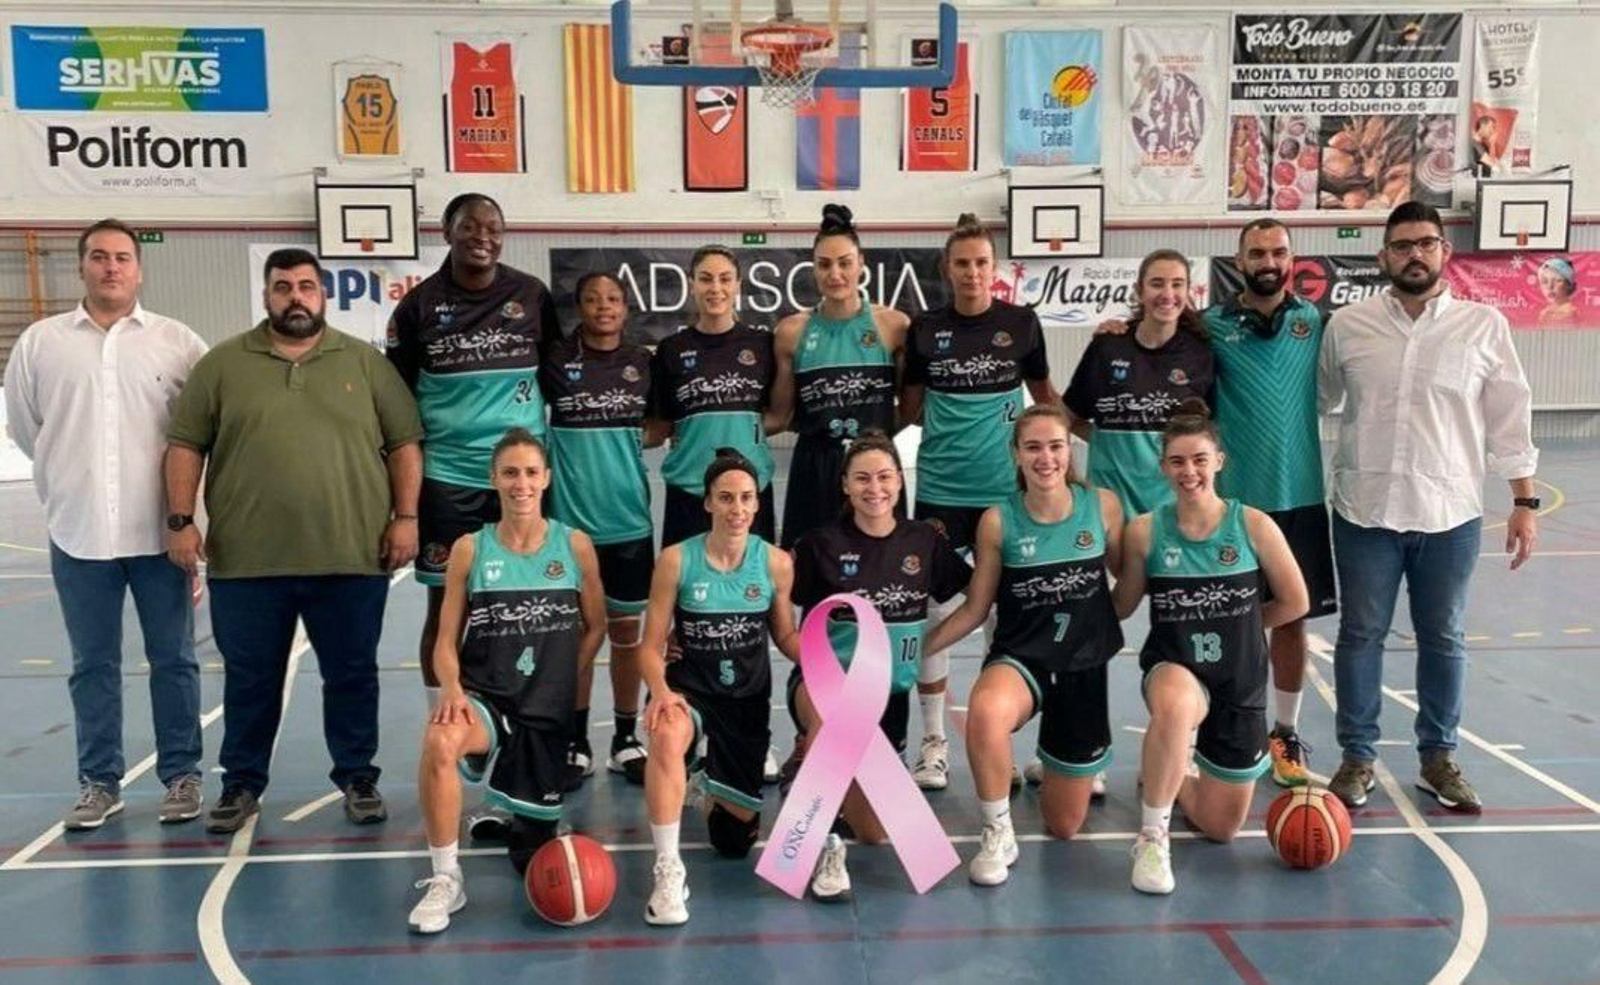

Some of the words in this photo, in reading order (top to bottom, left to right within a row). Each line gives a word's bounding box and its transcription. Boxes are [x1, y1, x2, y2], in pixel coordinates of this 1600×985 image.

[1242, 22, 1285, 53] Todo
[1284, 17, 1355, 50] Bueno
[59, 52, 221, 92] SERHVAS
[1237, 68, 1292, 80] MONTA
[1298, 68, 1318, 80] TU
[1323, 67, 1381, 79] PROPIO
[1386, 66, 1455, 79] NEGOCIO
[472, 85, 496, 119] 11
[930, 86, 949, 118] 5
[1244, 82, 1331, 98] INFÓRMATE
[1339, 82, 1371, 98] 600
[1374, 82, 1396, 97] 49
[1402, 81, 1421, 97] 18
[1425, 81, 1447, 97] 20
[357, 93, 383, 118] 15
[1264, 101, 1427, 113] www.todobueno.es
[47, 126, 248, 169] Poliform
[914, 127, 965, 142] CANALS
[102, 177, 197, 188] www.poliform.it
[1053, 612, 1072, 643] 7
[516, 646, 536, 676] 4
[901, 636, 918, 663] 10
[1191, 632, 1222, 663] 13
[720, 659, 736, 686] 5
